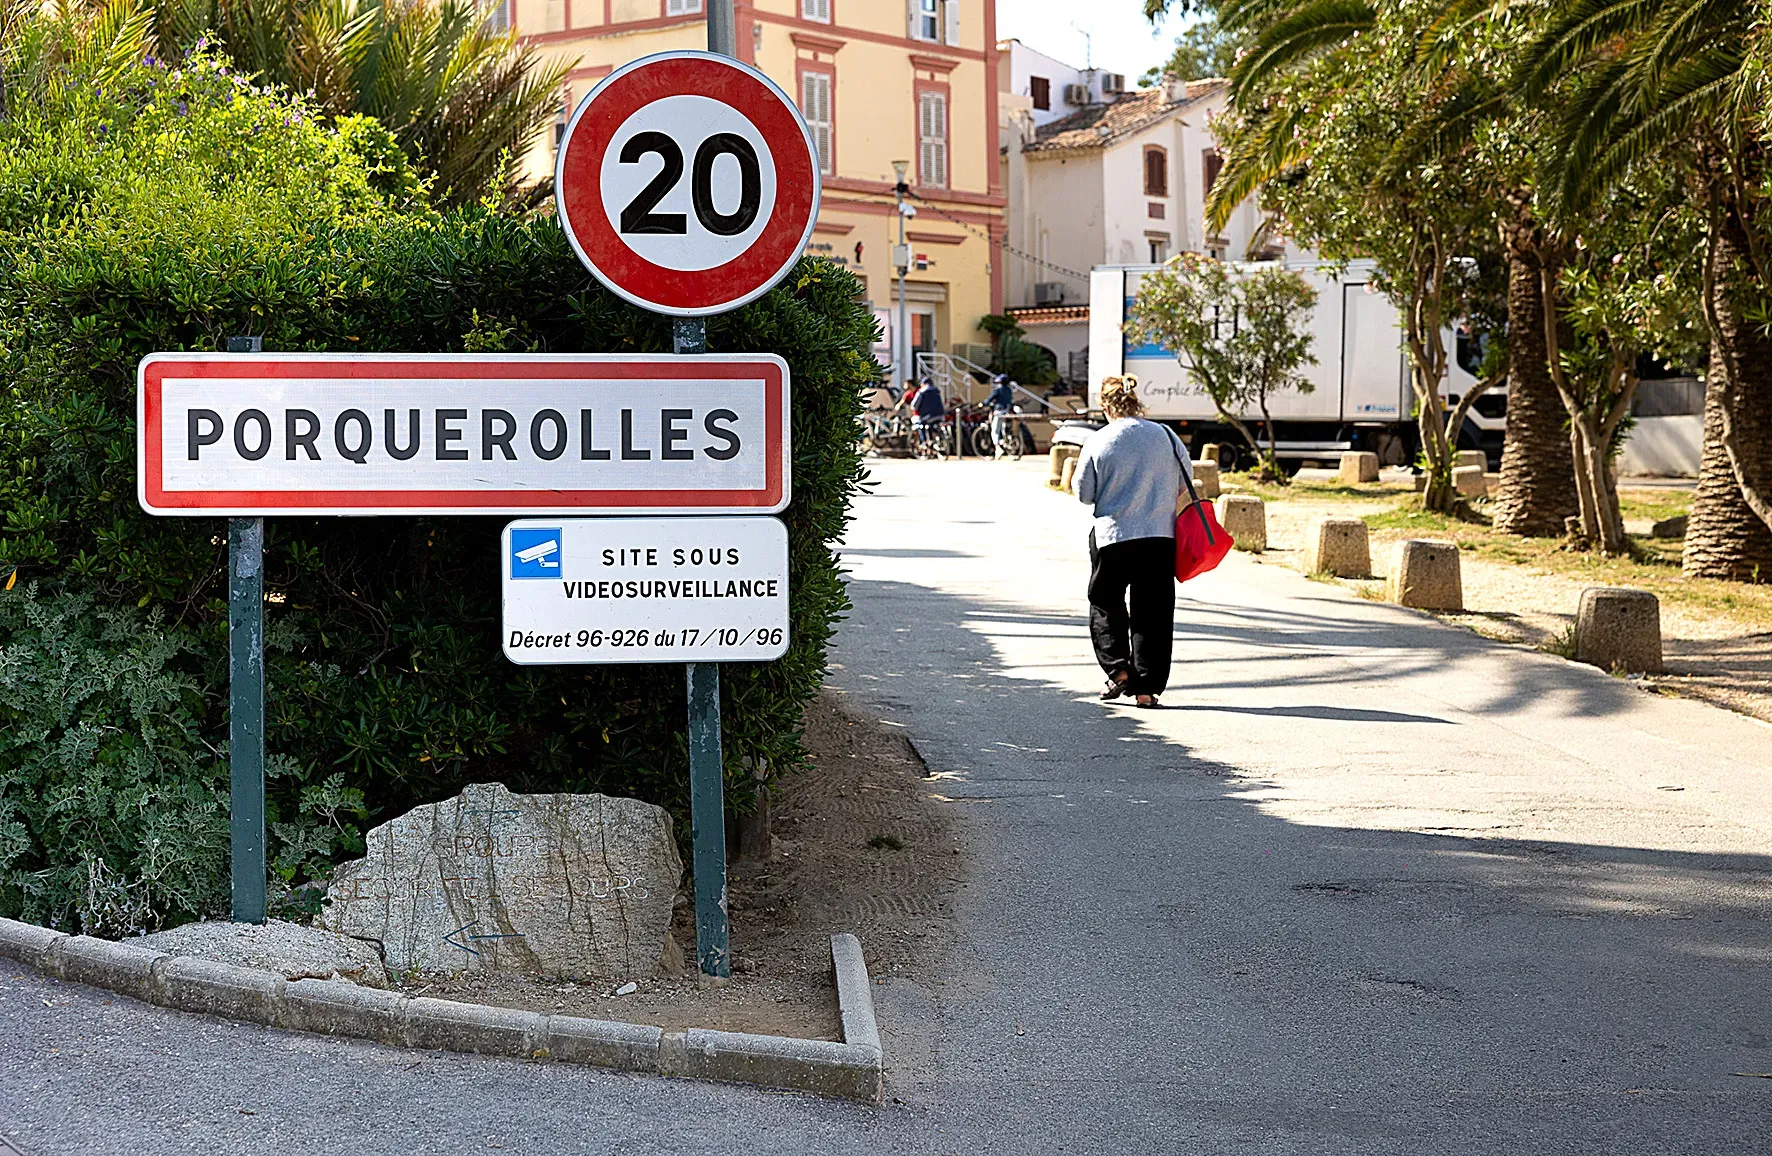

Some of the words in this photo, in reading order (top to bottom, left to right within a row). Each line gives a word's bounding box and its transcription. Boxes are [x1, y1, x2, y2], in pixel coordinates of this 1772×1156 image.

[618, 131, 762, 236] 20
[187, 408, 742, 464] PORQUEROLLES
[602, 548, 658, 566] SITE
[673, 548, 740, 566] SOUS
[563, 580, 778, 599] VIDEOSURVEILLANCE
[509, 630, 571, 648] Décret
[576, 629, 649, 647] 96-926
[654, 629, 675, 646] du
[512, 875, 649, 899] SECOURS
